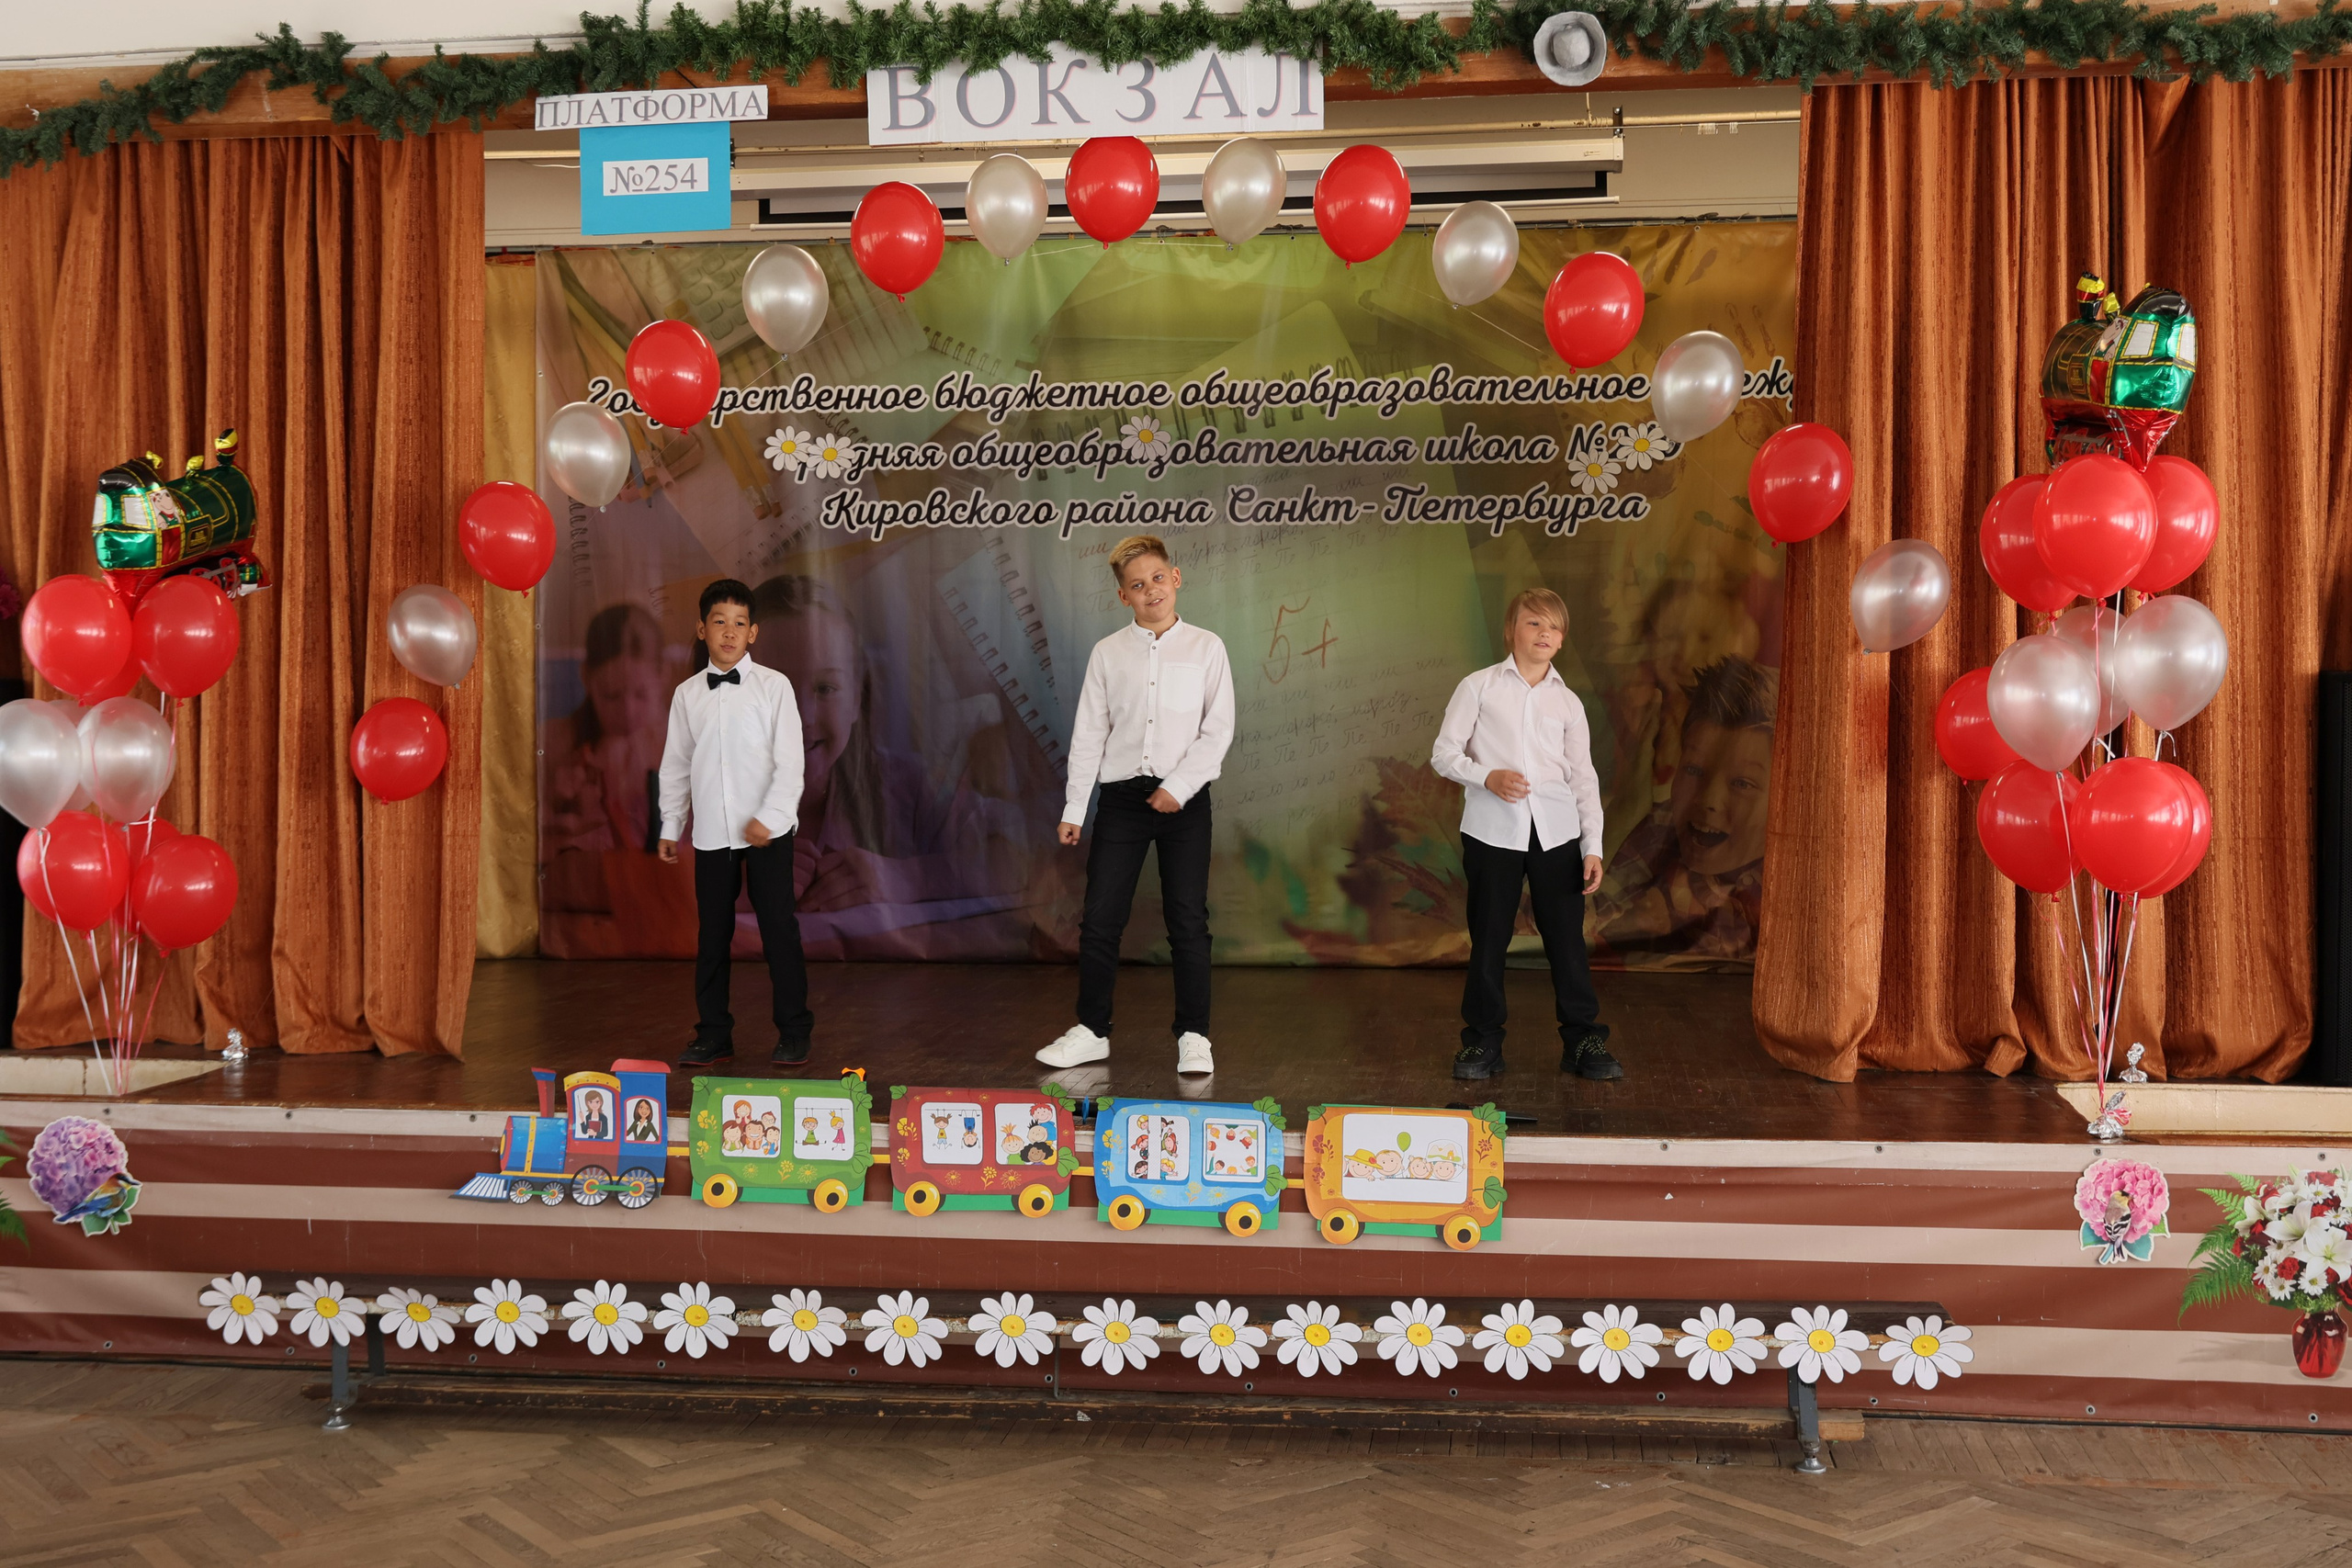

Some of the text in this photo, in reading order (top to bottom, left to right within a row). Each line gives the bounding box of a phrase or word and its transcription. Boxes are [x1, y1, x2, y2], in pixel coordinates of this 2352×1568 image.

[537, 89, 765, 129] ПЛАТФОРМА
[880, 52, 1319, 131] ВОКЗАЛ
[609, 163, 698, 194] №254
[935, 373, 1170, 423] бюджетное
[1181, 367, 1652, 417] общеобразовательное
[1424, 425, 1556, 462] школа
[823, 490, 1058, 540] Кировского
[1062, 493, 1212, 539] района
[1229, 482, 1648, 535] Санкт-Петербурга
[1262, 595, 1340, 685] 5+
